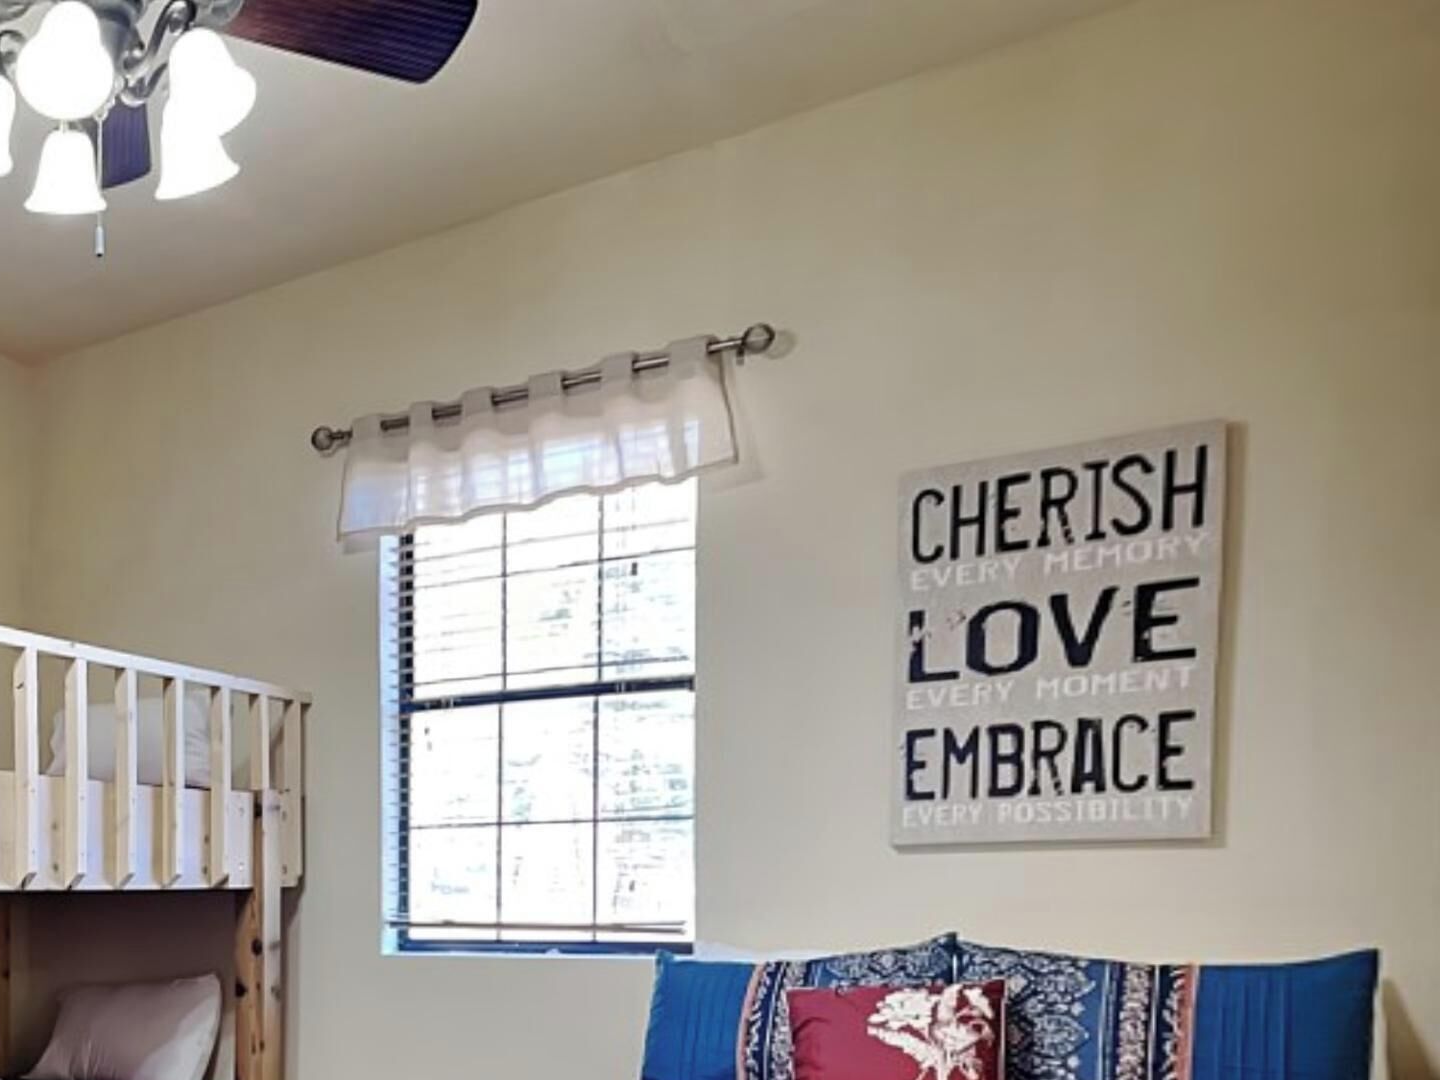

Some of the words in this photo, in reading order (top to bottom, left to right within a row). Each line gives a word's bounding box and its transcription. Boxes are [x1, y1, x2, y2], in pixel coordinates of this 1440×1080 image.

[911, 445, 1208, 564] CHERISH
[910, 557, 1022, 591] EVERY
[1043, 532, 1213, 574] MEMORY
[908, 577, 1200, 684] LOVE
[906, 680, 1014, 711] EVERY
[1036, 666, 1195, 700] MOMENT
[905, 709, 1197, 802] EMBRACE
[902, 801, 982, 828] EVERY
[997, 795, 1194, 825] POSSIBILITY
